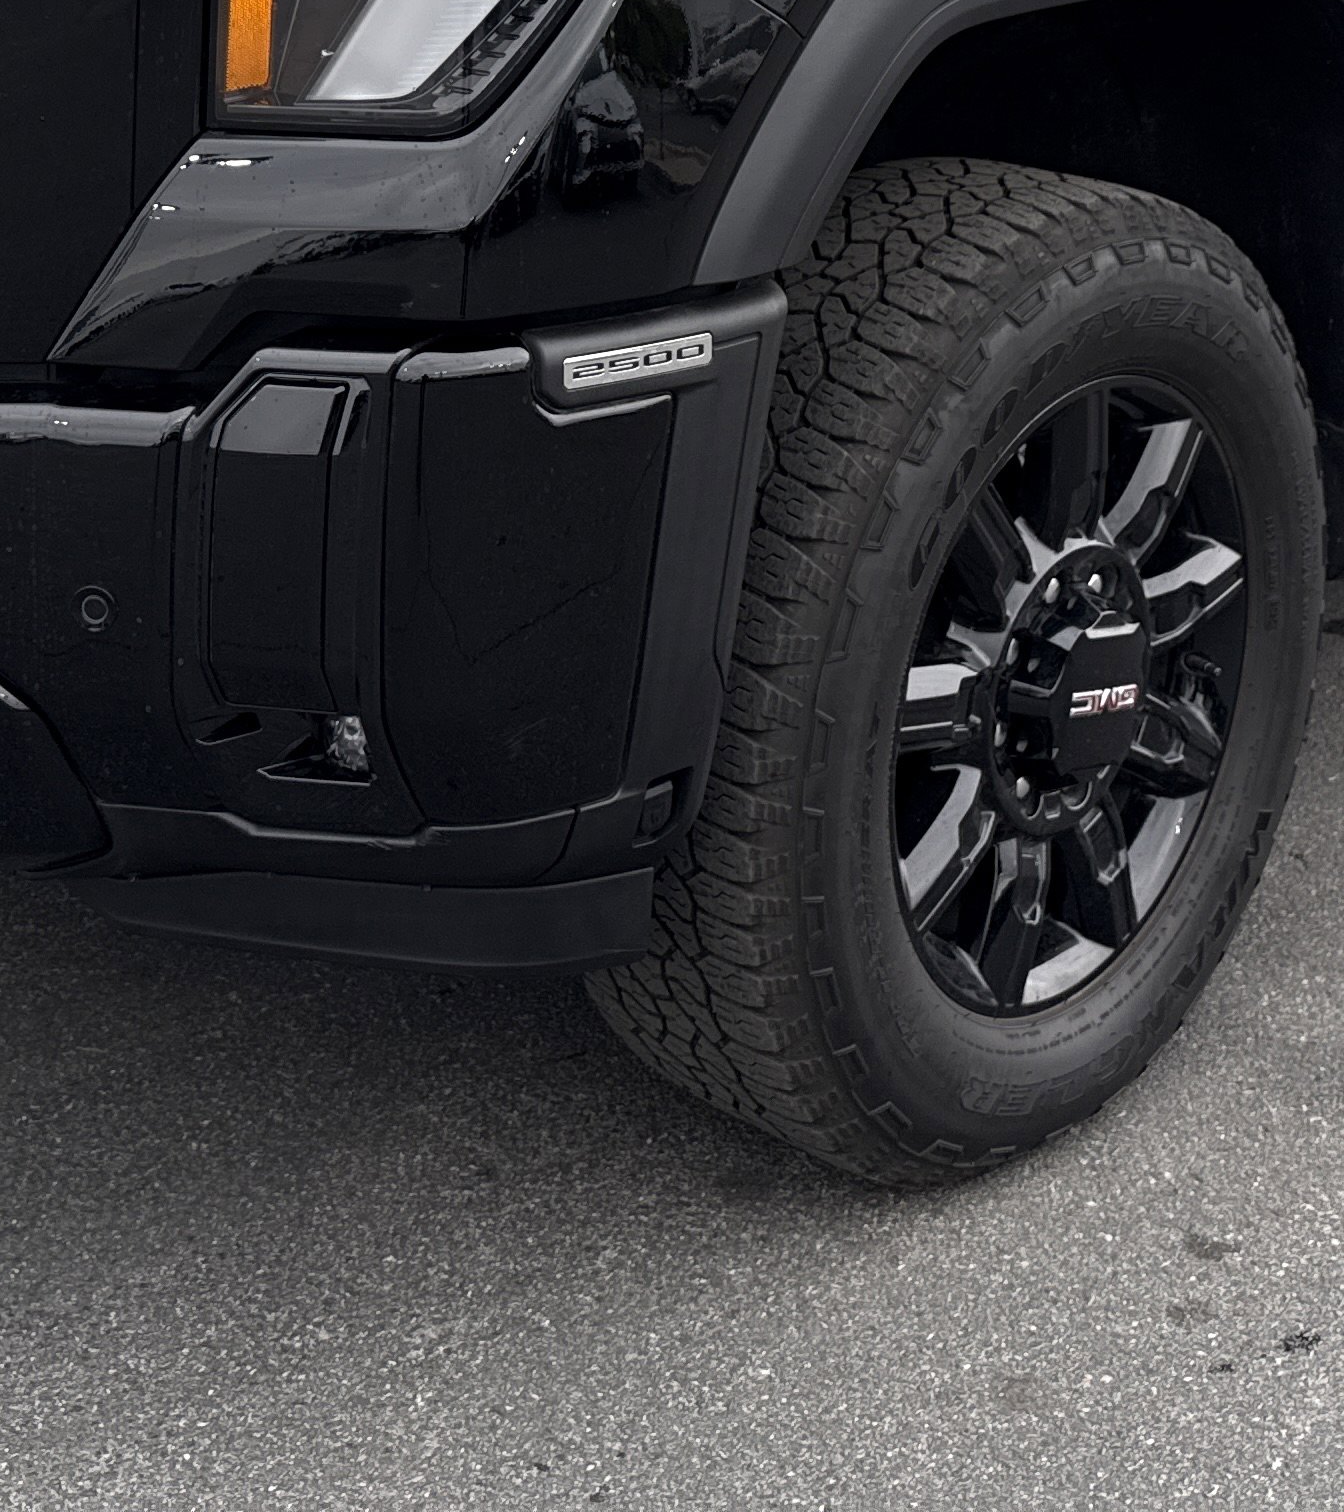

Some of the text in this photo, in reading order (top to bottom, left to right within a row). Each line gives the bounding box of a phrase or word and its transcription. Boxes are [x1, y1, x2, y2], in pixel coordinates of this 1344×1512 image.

[571, 342, 706, 381] 2500
[908, 292, 1251, 590] GOODYEAR
[1069, 683, 1139, 719] GMC
